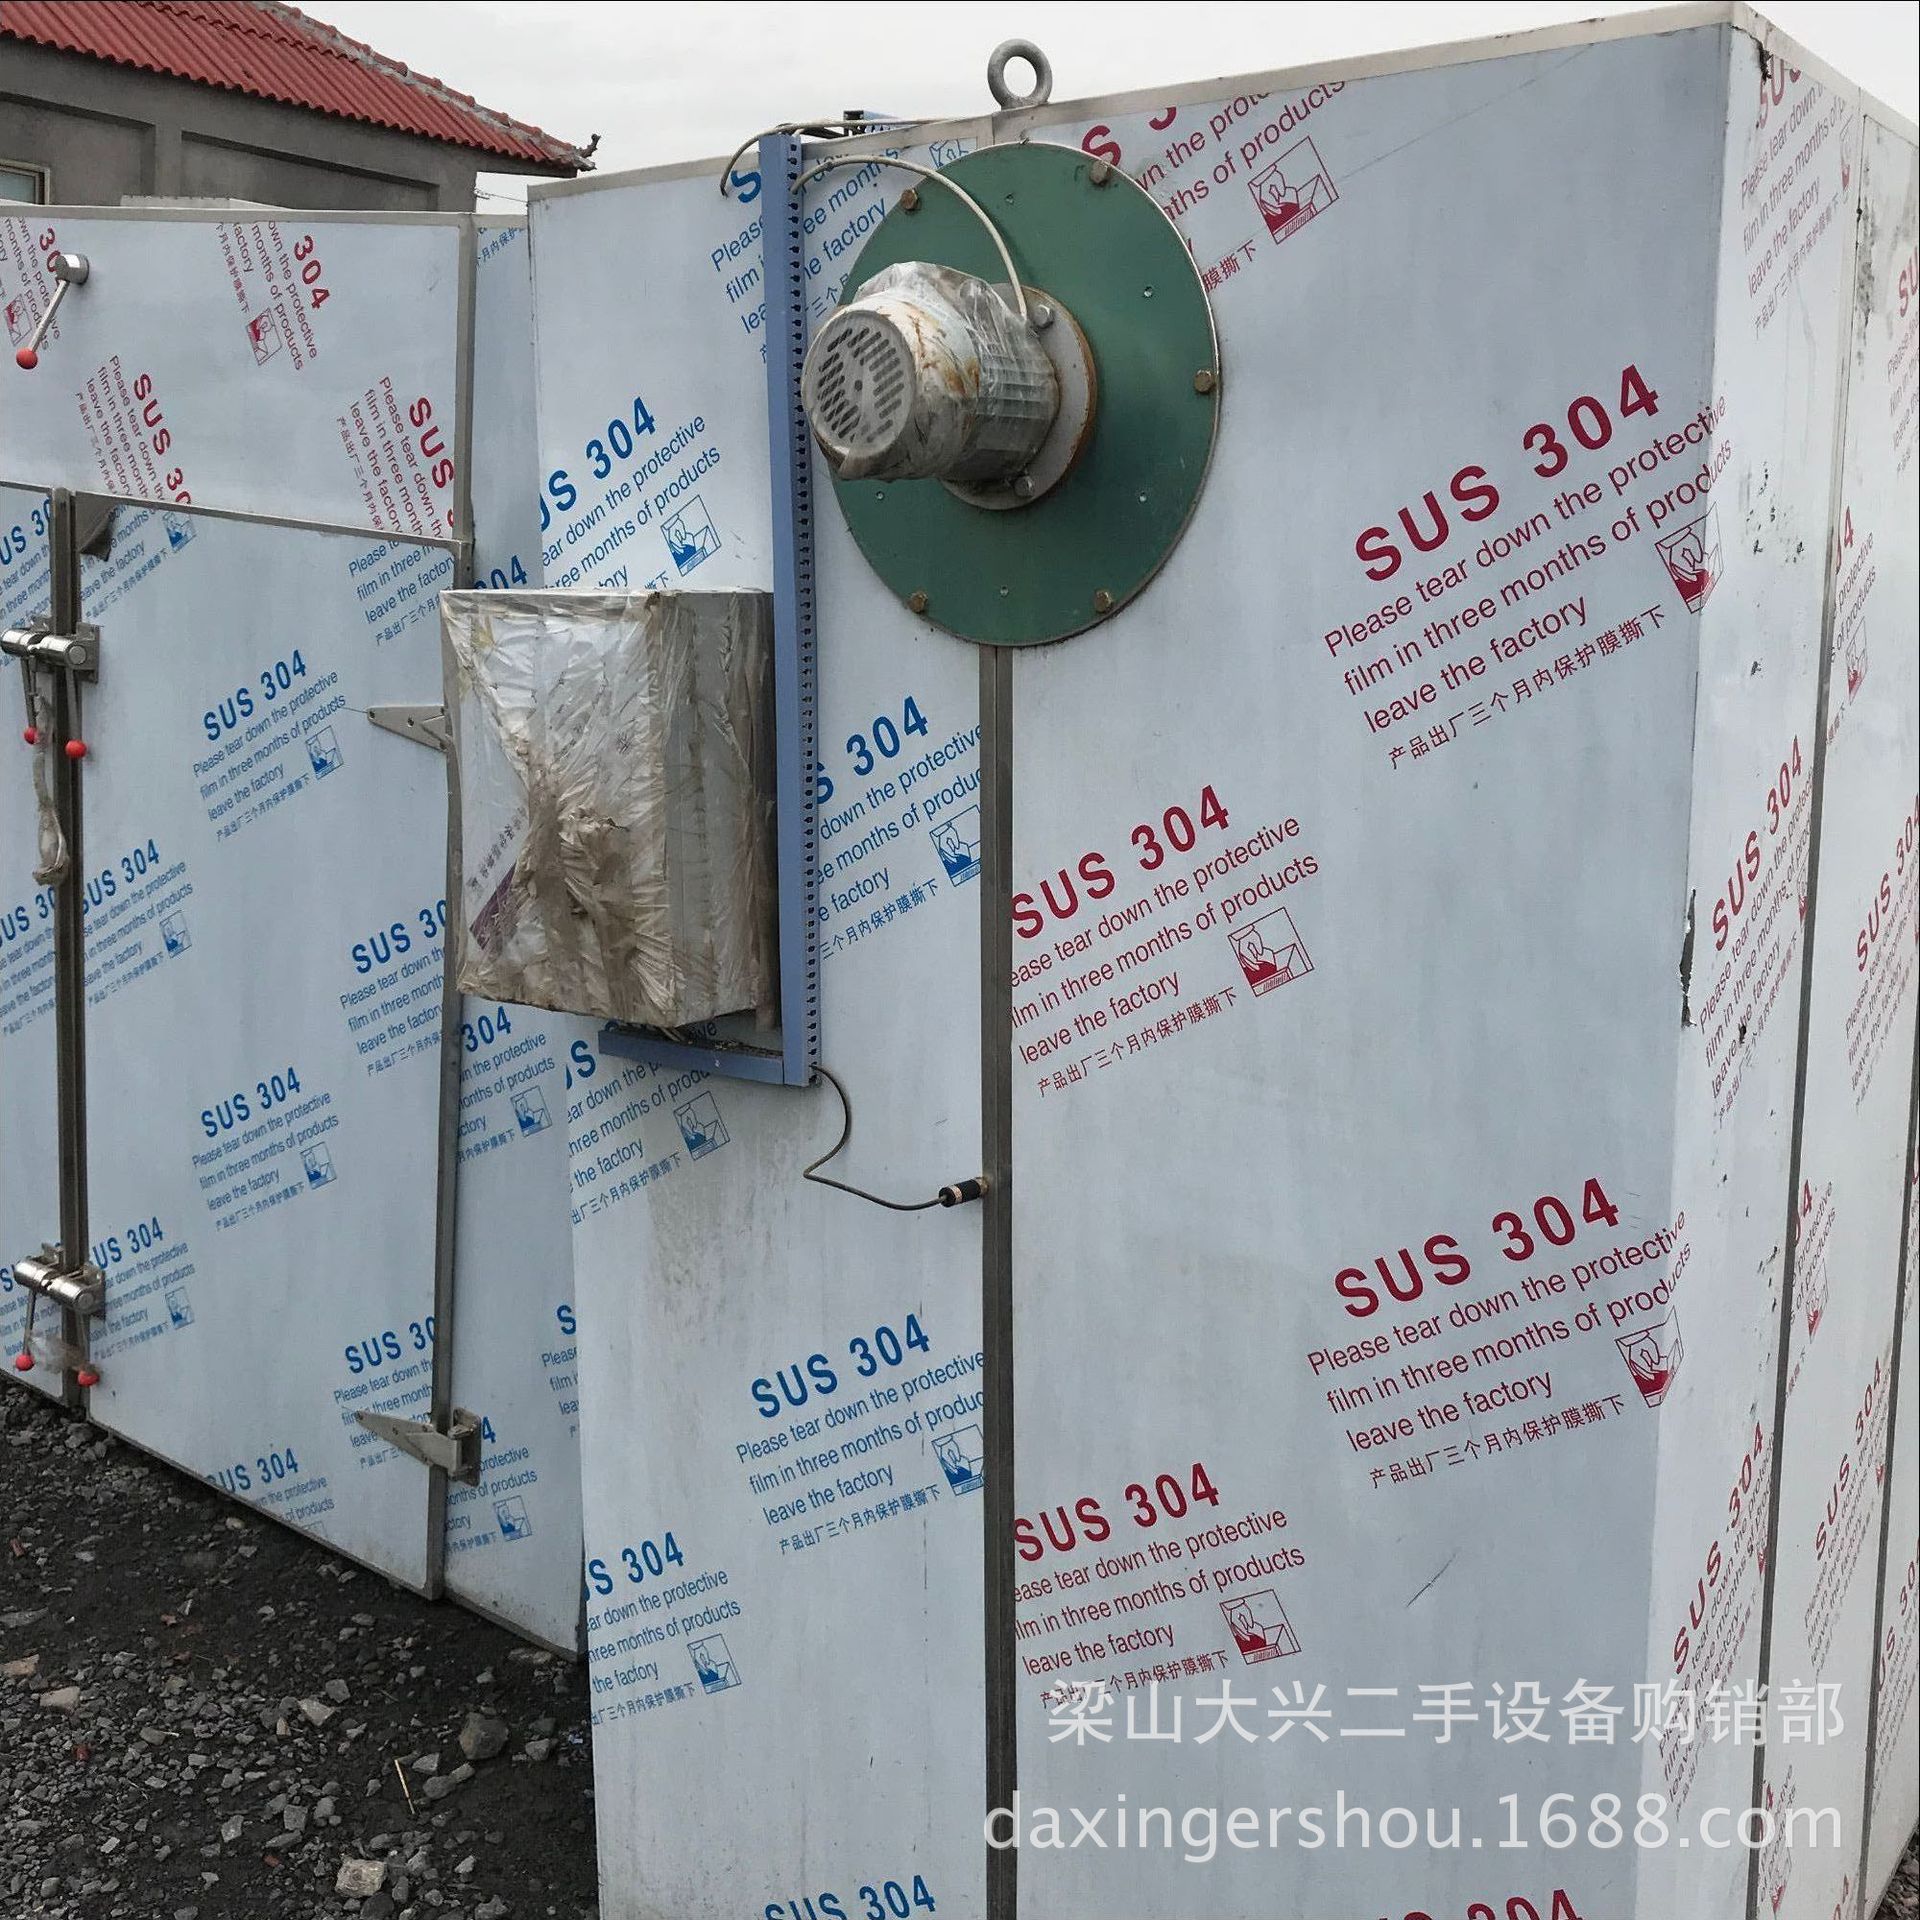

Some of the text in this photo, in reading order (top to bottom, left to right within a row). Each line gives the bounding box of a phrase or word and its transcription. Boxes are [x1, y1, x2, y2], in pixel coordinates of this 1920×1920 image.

[1166, 132, 1205, 168] the
[823, 198, 887, 262] factory
[252, 225, 303, 370] months products
[294, 235, 330, 309] 304
[286, 282, 317, 358] protective
[133, 373, 171, 456] SUS
[409, 397, 454, 489] SUS
[586, 397, 655, 479] 304
[566, 417, 705, 544] down protective
[581, 448, 720, 573] months products
[1356, 364, 1659, 581] SUS 304
[1325, 396, 1727, 657] Please tear down the protective
[1344, 438, 1734, 695] film in three months of products
[204, 650, 306, 740] SUS 304
[1364, 597, 1585, 733] leave the factory
[1389, 605, 1664, 769] 产品出厂三个月内保护膜撕下
[193, 672, 338, 777] Please the protective
[254, 696, 348, 763] months products
[847, 696, 928, 776] 304
[208, 764, 283, 821] leave factory
[821, 803, 865, 839] down
[836, 822, 899, 870] months
[1012, 785, 1229, 938] SUS 304
[1712, 734, 1802, 951] SUS 304
[831, 868, 889, 913] factory
[1010, 818, 1299, 986] ease tear down the protective
[1857, 872, 1892, 973] SUS
[352, 923, 410, 973] SUS
[1039, 856, 1318, 1012] in three months of products
[340, 971, 398, 1009] Please tear
[460, 1006, 511, 1052] 304
[1019, 972, 1178, 1064] leave the factory
[492, 1034, 546, 1070] protective
[1038, 987, 1236, 1097] 产品出厂三个月内保护膜撕下
[597, 1139, 643, 1174] factory
[600, 1100, 649, 1137] months
[127, 1216, 163, 1254] 304
[1335, 1178, 1619, 1317] SUS 304
[1307, 1210, 1686, 1375] Please tear down the protective
[1327, 1243, 1692, 1413] film in three months of products
[334, 1384, 368, 1404] Please
[345, 1332, 401, 1373] SUS
[752, 1314, 930, 1418] SUS 304
[736, 1353, 984, 1463] Please tear down the protective
[750, 1392, 984, 1494] film three months produc
[1346, 1372, 1551, 1452] leave the factory
[1370, 1394, 1624, 1489] 产品出厂三个月内保护膜撕下
[257, 1448, 298, 1484] 304
[763, 1465, 893, 1525] leave the factory
[1816, 1453, 1850, 1562] SUS
[1855, 1356, 1881, 1446] 304
[1014, 1463, 1219, 1561] SUS 304
[1673, 1540, 1721, 1674] SUS
[1729, 1421, 1763, 1529] 304
[622, 1532, 683, 1583] 304
[1014, 1511, 1287, 1601] ease tear down the protective
[1062, 1548, 1304, 1627] three months of products
[604, 1571, 728, 1625] down protective
[617, 1601, 740, 1653] months products
[593, 1662, 658, 1693] the factory
[1022, 1625, 1173, 1675] leave the factory
